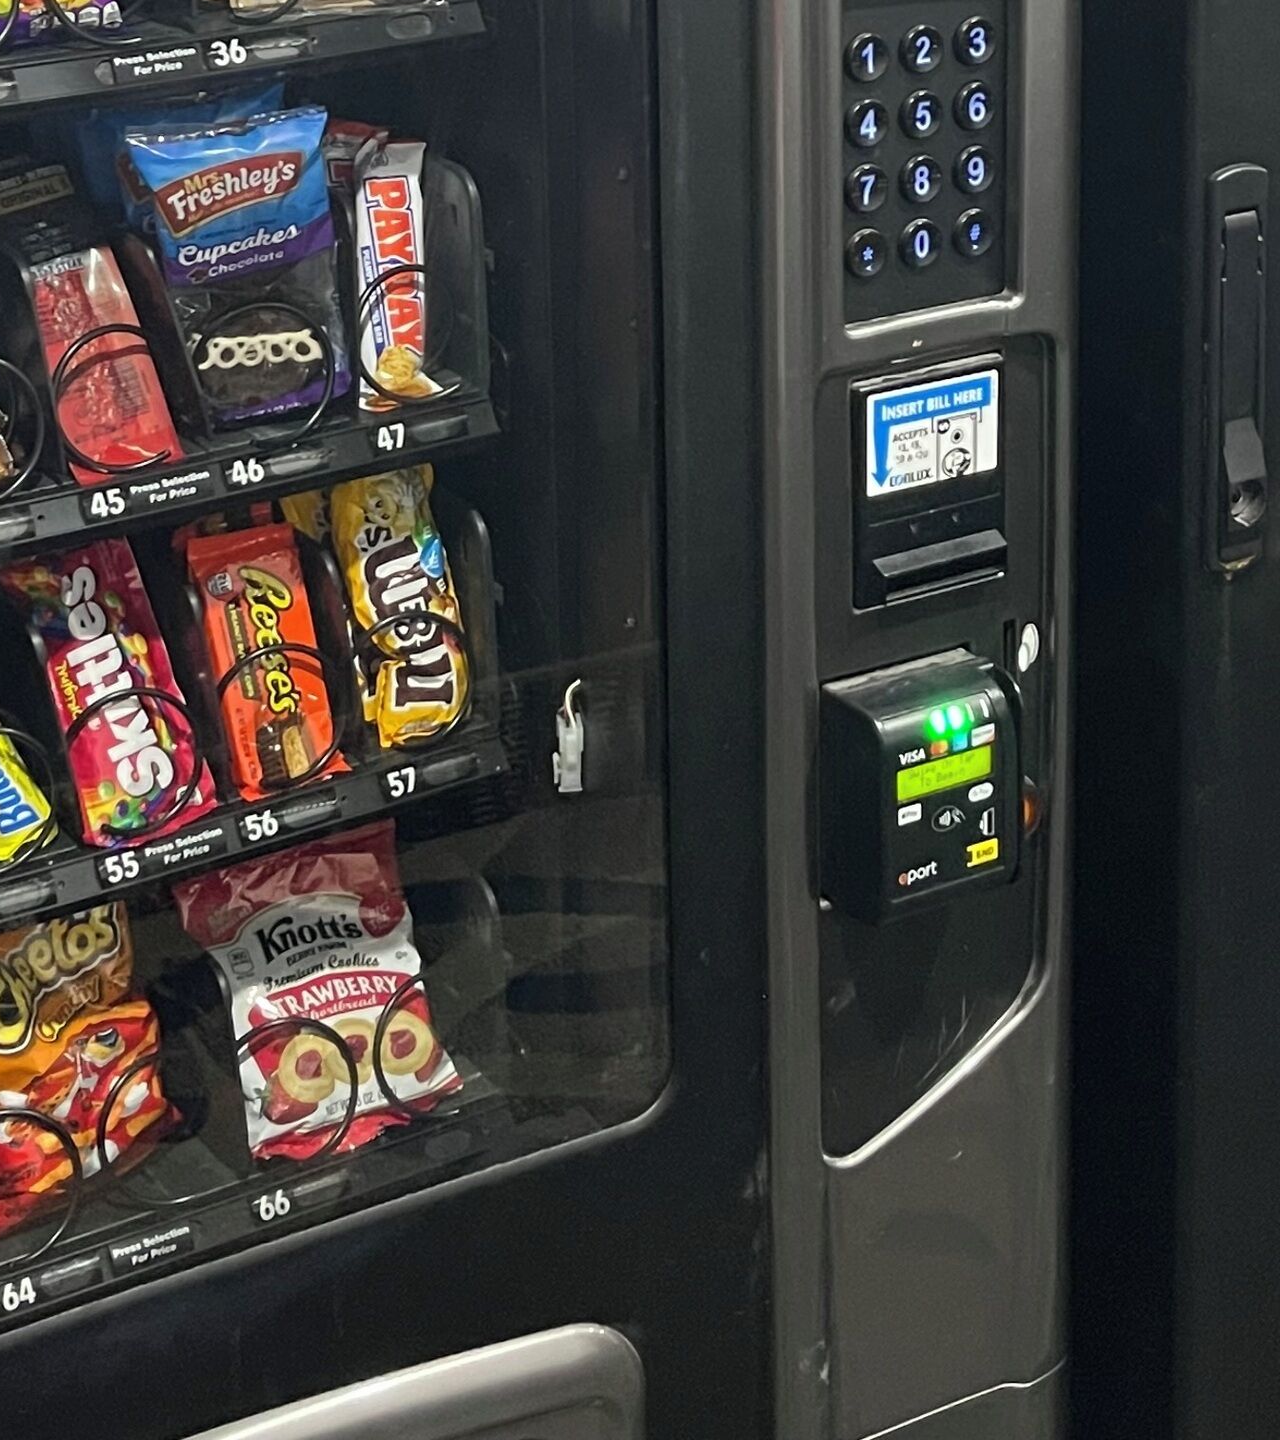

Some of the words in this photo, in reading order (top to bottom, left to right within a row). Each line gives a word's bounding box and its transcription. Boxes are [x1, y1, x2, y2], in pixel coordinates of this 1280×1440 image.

[211, 38, 247, 65] 36
[861, 42, 874, 75] 1
[915, 35, 931, 65] 2
[968, 26, 986, 57] 3
[859, 109, 877, 140] 4
[914, 101, 932, 132] 5
[968, 91, 986, 123] 6
[167, 161, 296, 222] Freshley's
[860, 173, 876, 206] 7
[914, 165, 930, 197] 8
[967, 156, 985, 187] 9
[178, 222, 302, 267] Cupcakes
[914, 229, 930, 259] 0
[208, 250, 285, 278] Chocolate
[881, 399, 926, 422] INSERT
[927, 393, 951, 411] BILL
[953, 387, 983, 406] HERE
[377, 423, 406, 450] 47
[231, 459, 265, 484] 46
[90, 489, 126, 517] 45
[237, 565, 301, 714] Reese's
[61, 566, 175, 798] Skittles
[898, 748, 926, 765] VISA
[388, 767, 416, 797] 57
[245, 811, 279, 841] 56
[105, 851, 139, 882] 55
[164, 852, 182, 866] For
[184, 844, 210, 859] Price
[255, 913, 363, 965] Knott's
[262, 963, 325, 993] Premium
[327, 952, 380, 969] Cookies
[258, 1189, 290, 1221] 66
[2, 1277, 36, 1311] 64
